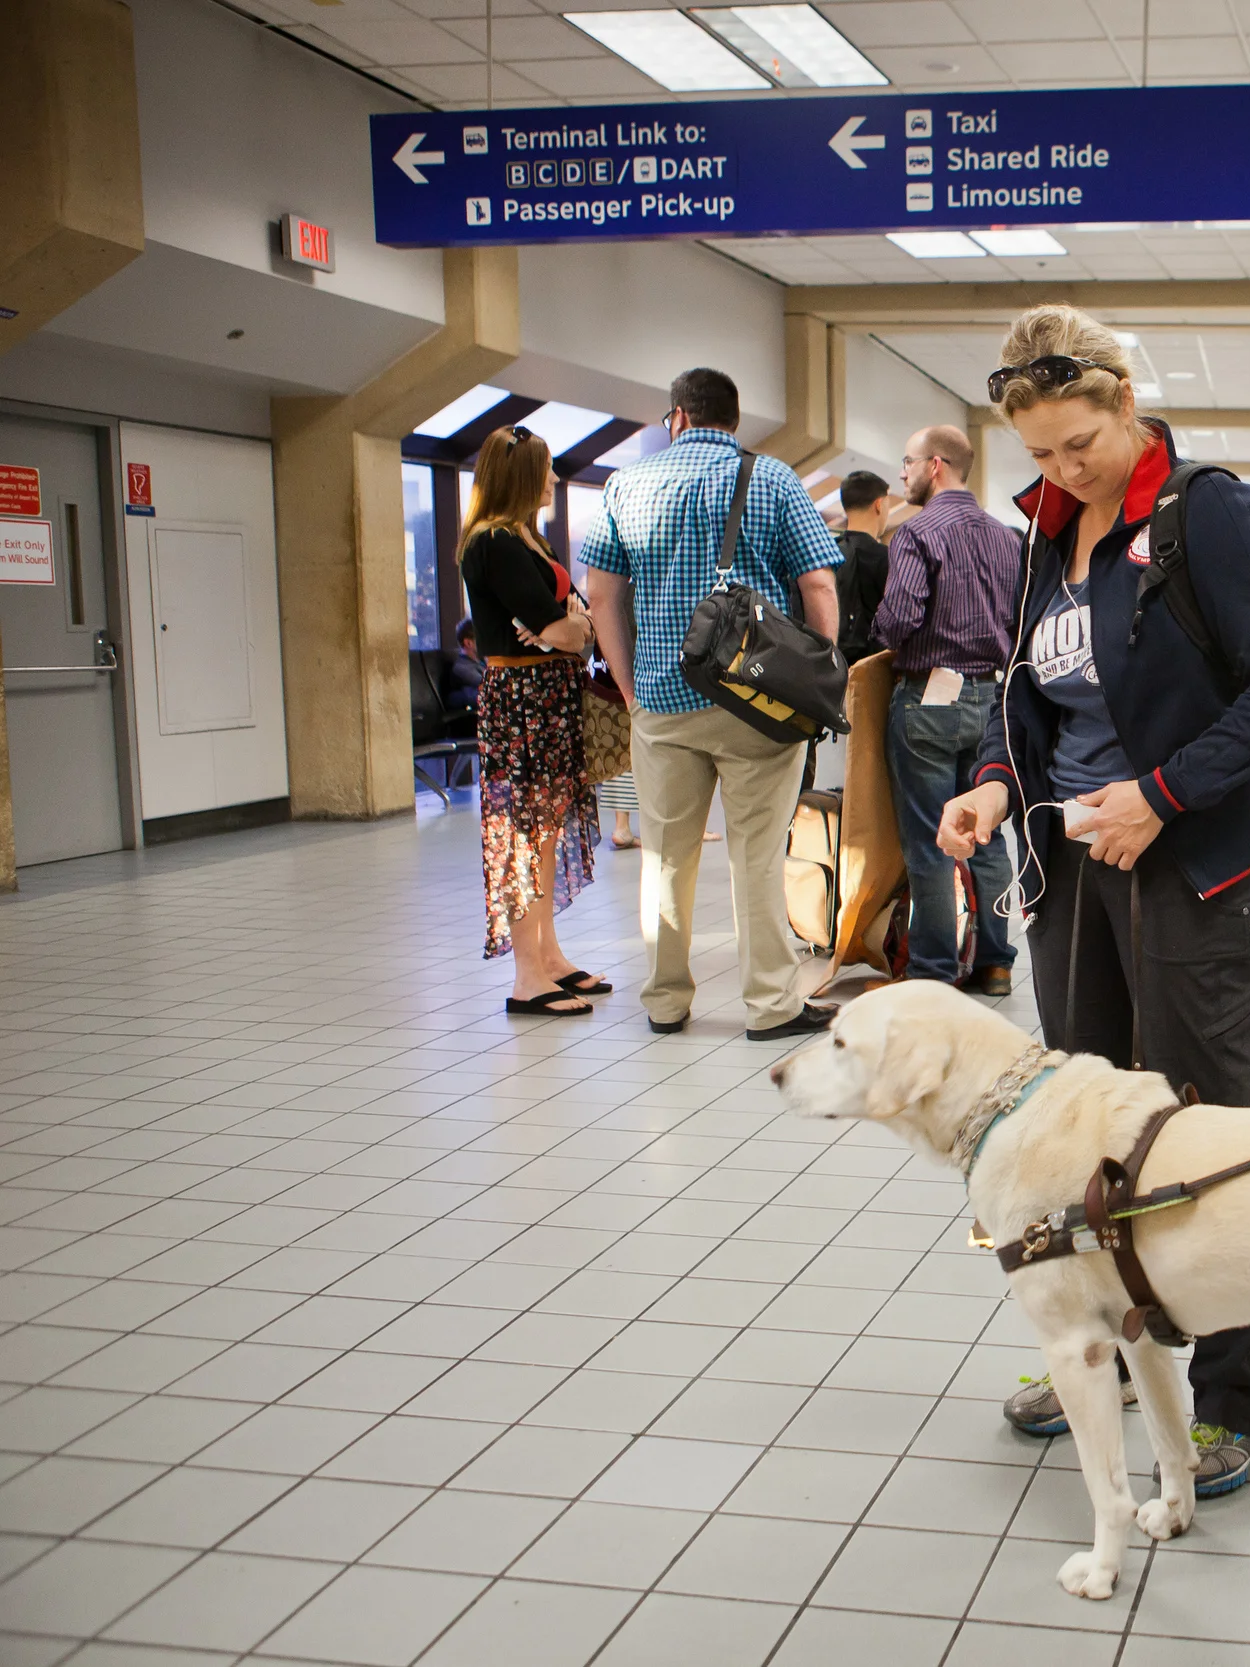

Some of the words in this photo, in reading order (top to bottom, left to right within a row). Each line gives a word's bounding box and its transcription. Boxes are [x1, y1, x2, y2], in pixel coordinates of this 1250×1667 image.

[502, 123, 608, 150] Terminal
[617, 120, 667, 146] Link
[674, 123, 706, 144] to:
[947, 109, 997, 135] Taxi
[511, 165, 526, 186] B
[538, 164, 553, 184] C
[566, 163, 582, 183] D
[661, 156, 728, 181] DART
[947, 145, 1040, 172] Shared
[1050, 143, 1110, 169] Ride
[947, 181, 1083, 208] Limousine
[503, 198, 632, 226] Passenger
[641, 192, 735, 222] Pick-up
[298, 220, 329, 265] EXIT
[4, 538, 22, 549] Exit
[24, 540, 46, 553] Only
[8, 554, 23, 564] Will
[24, 554, 49, 565] Sound
[1060, 657, 1070, 672] BE
